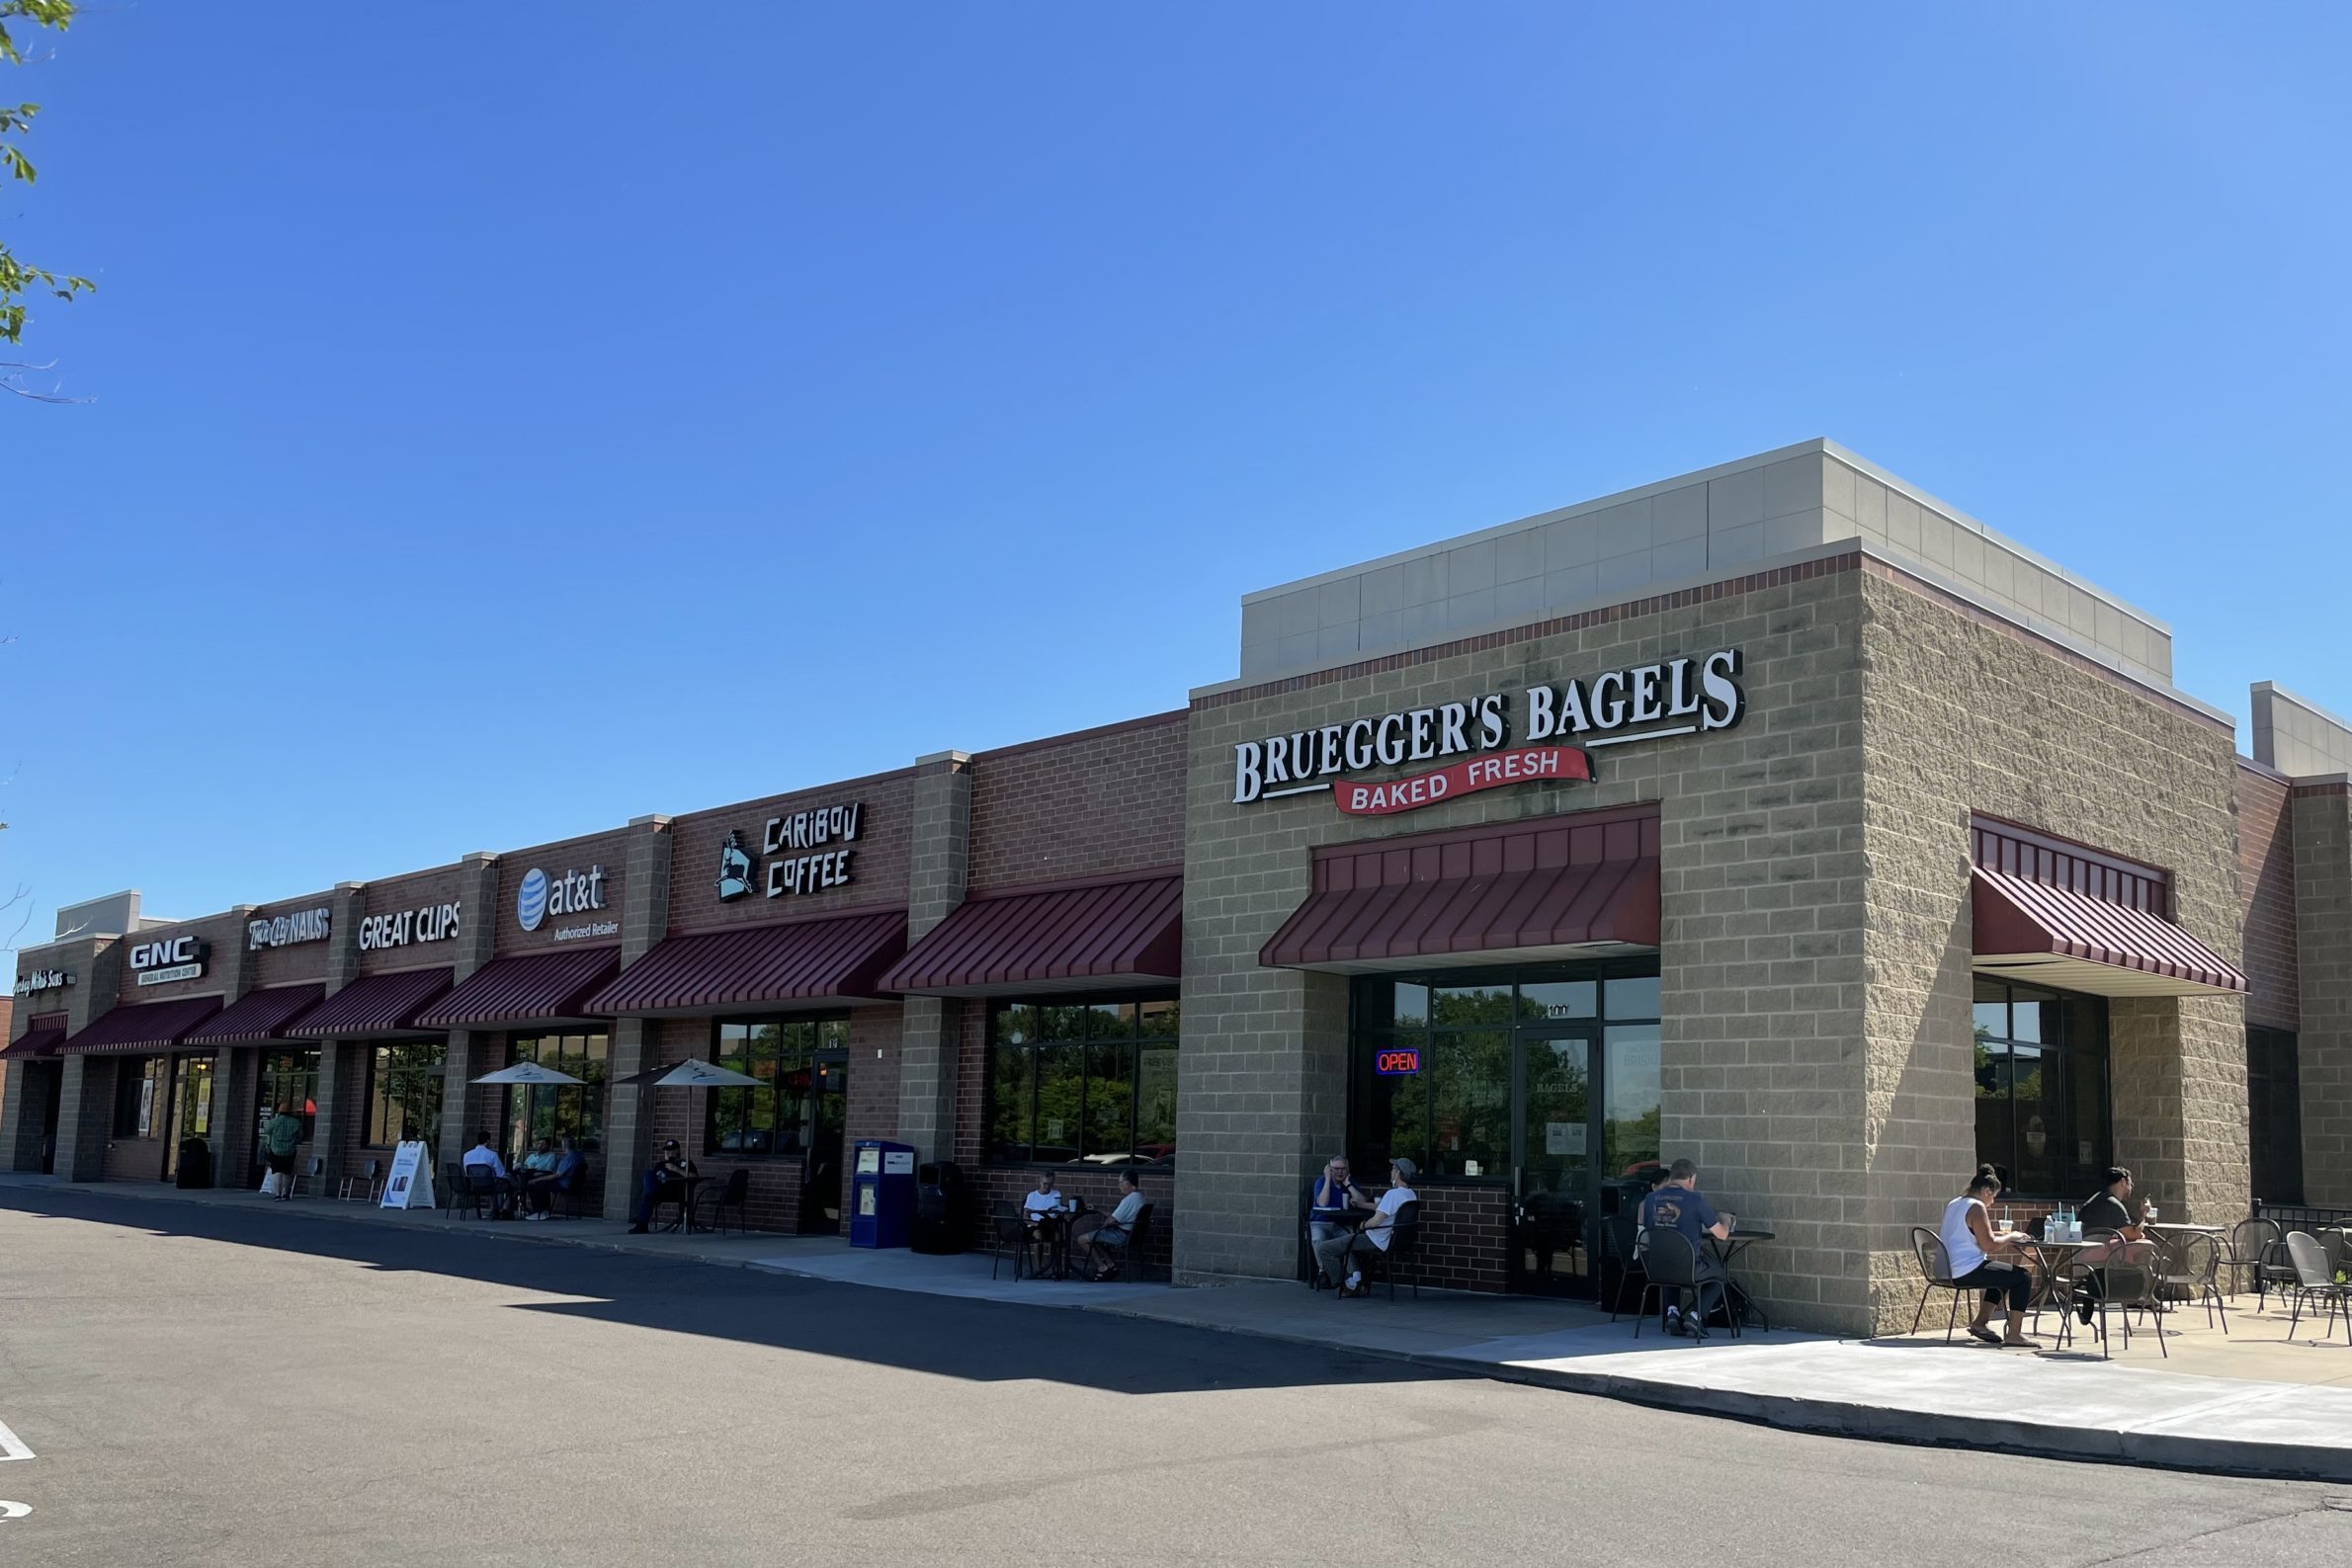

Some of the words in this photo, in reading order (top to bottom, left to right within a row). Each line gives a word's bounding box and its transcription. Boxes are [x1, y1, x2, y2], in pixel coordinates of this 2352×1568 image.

[1231, 693, 1503, 804] BRUEGGER'S
[1526, 648, 1738, 741] BAGELS
[1350, 774, 1449, 811] BAKED
[1468, 750, 1559, 786] FRESH
[762, 801, 860, 856] CARIBOU
[548, 864, 602, 917] at&t
[766, 849, 851, 899] COFFEE
[290, 908, 325, 945] NAILS
[359, 910, 414, 950] GREAT
[416, 900, 461, 943] CLIPS
[553, 923, 591, 942] Authorized
[592, 920, 619, 938] Retailer
[129, 935, 194, 969] GNC
[1379, 1052, 1417, 1071] OPEN
[1537, 1082, 1578, 1093] BAGELS
